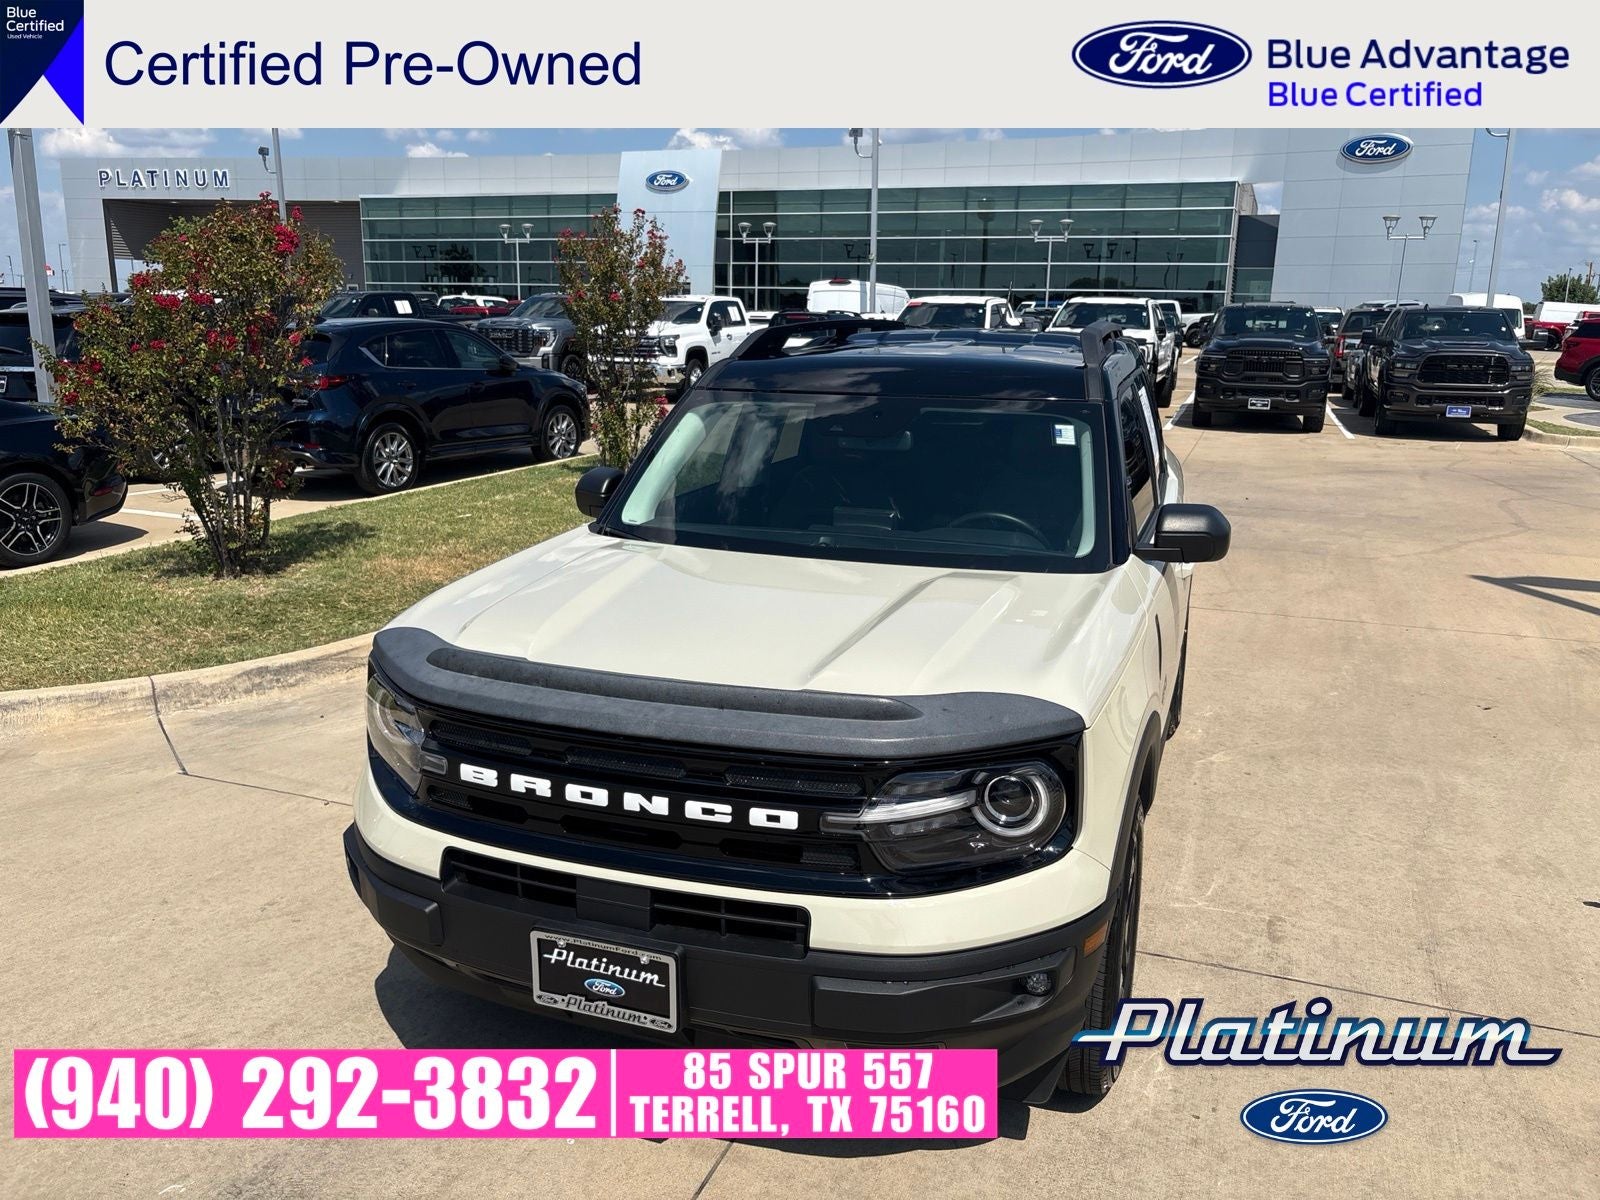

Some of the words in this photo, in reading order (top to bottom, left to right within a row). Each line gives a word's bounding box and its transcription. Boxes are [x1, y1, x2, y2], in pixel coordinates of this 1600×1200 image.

[1355, 139, 1397, 157] Ford
[98, 169, 229, 187] PLATINUM
[459, 763, 799, 830] BRONCO
[543, 947, 666, 988] Platinum
[564, 996, 648, 1025] Platinum
